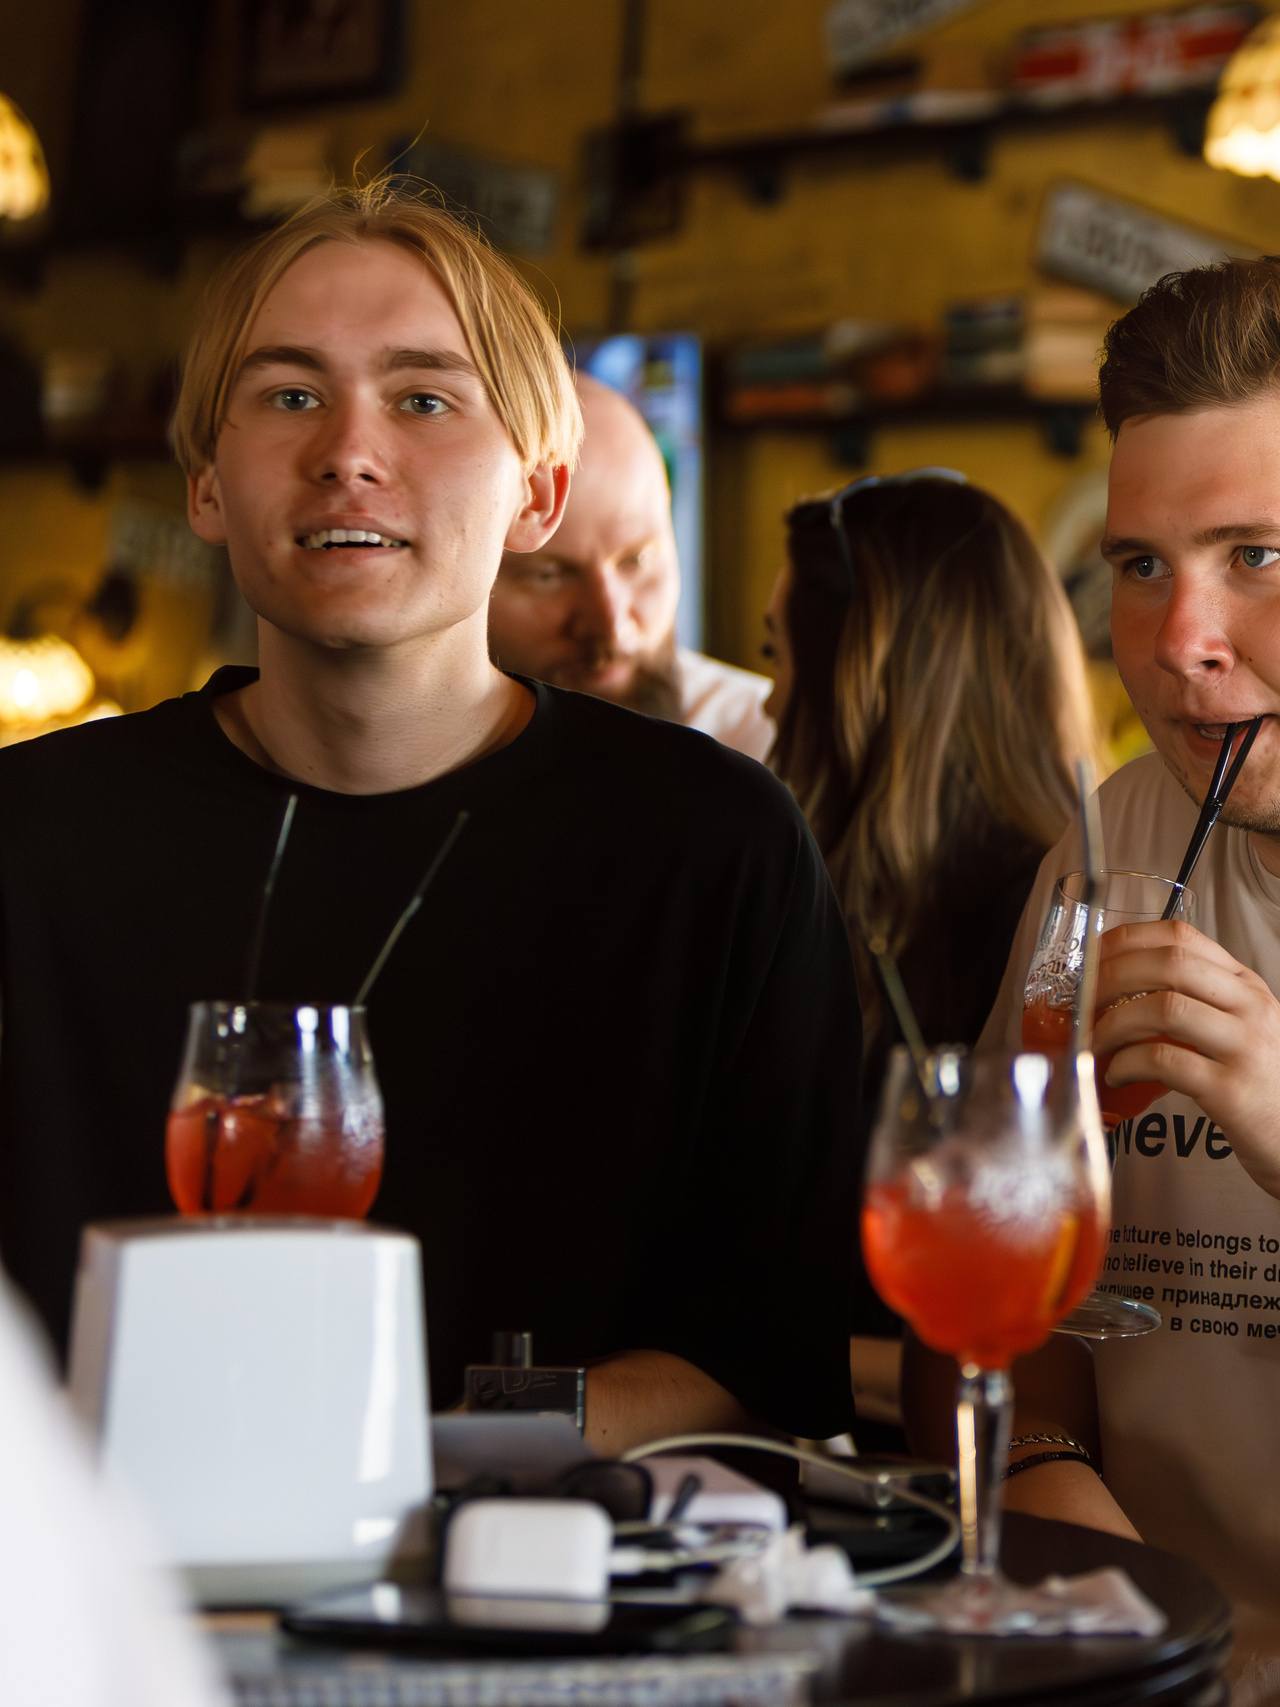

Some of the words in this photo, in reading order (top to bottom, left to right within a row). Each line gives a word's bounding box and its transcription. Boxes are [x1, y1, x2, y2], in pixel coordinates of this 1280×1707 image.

[1115, 1112, 1234, 1160] Neve
[1176, 1228, 1252, 1255] belongs
[1258, 1234, 1280, 1253] to
[1123, 1253, 1184, 1275] believe
[1189, 1257, 1204, 1277] in
[1209, 1259, 1257, 1280] their
[1170, 1317, 1183, 1331] в
[1190, 1318, 1239, 1336] свою
